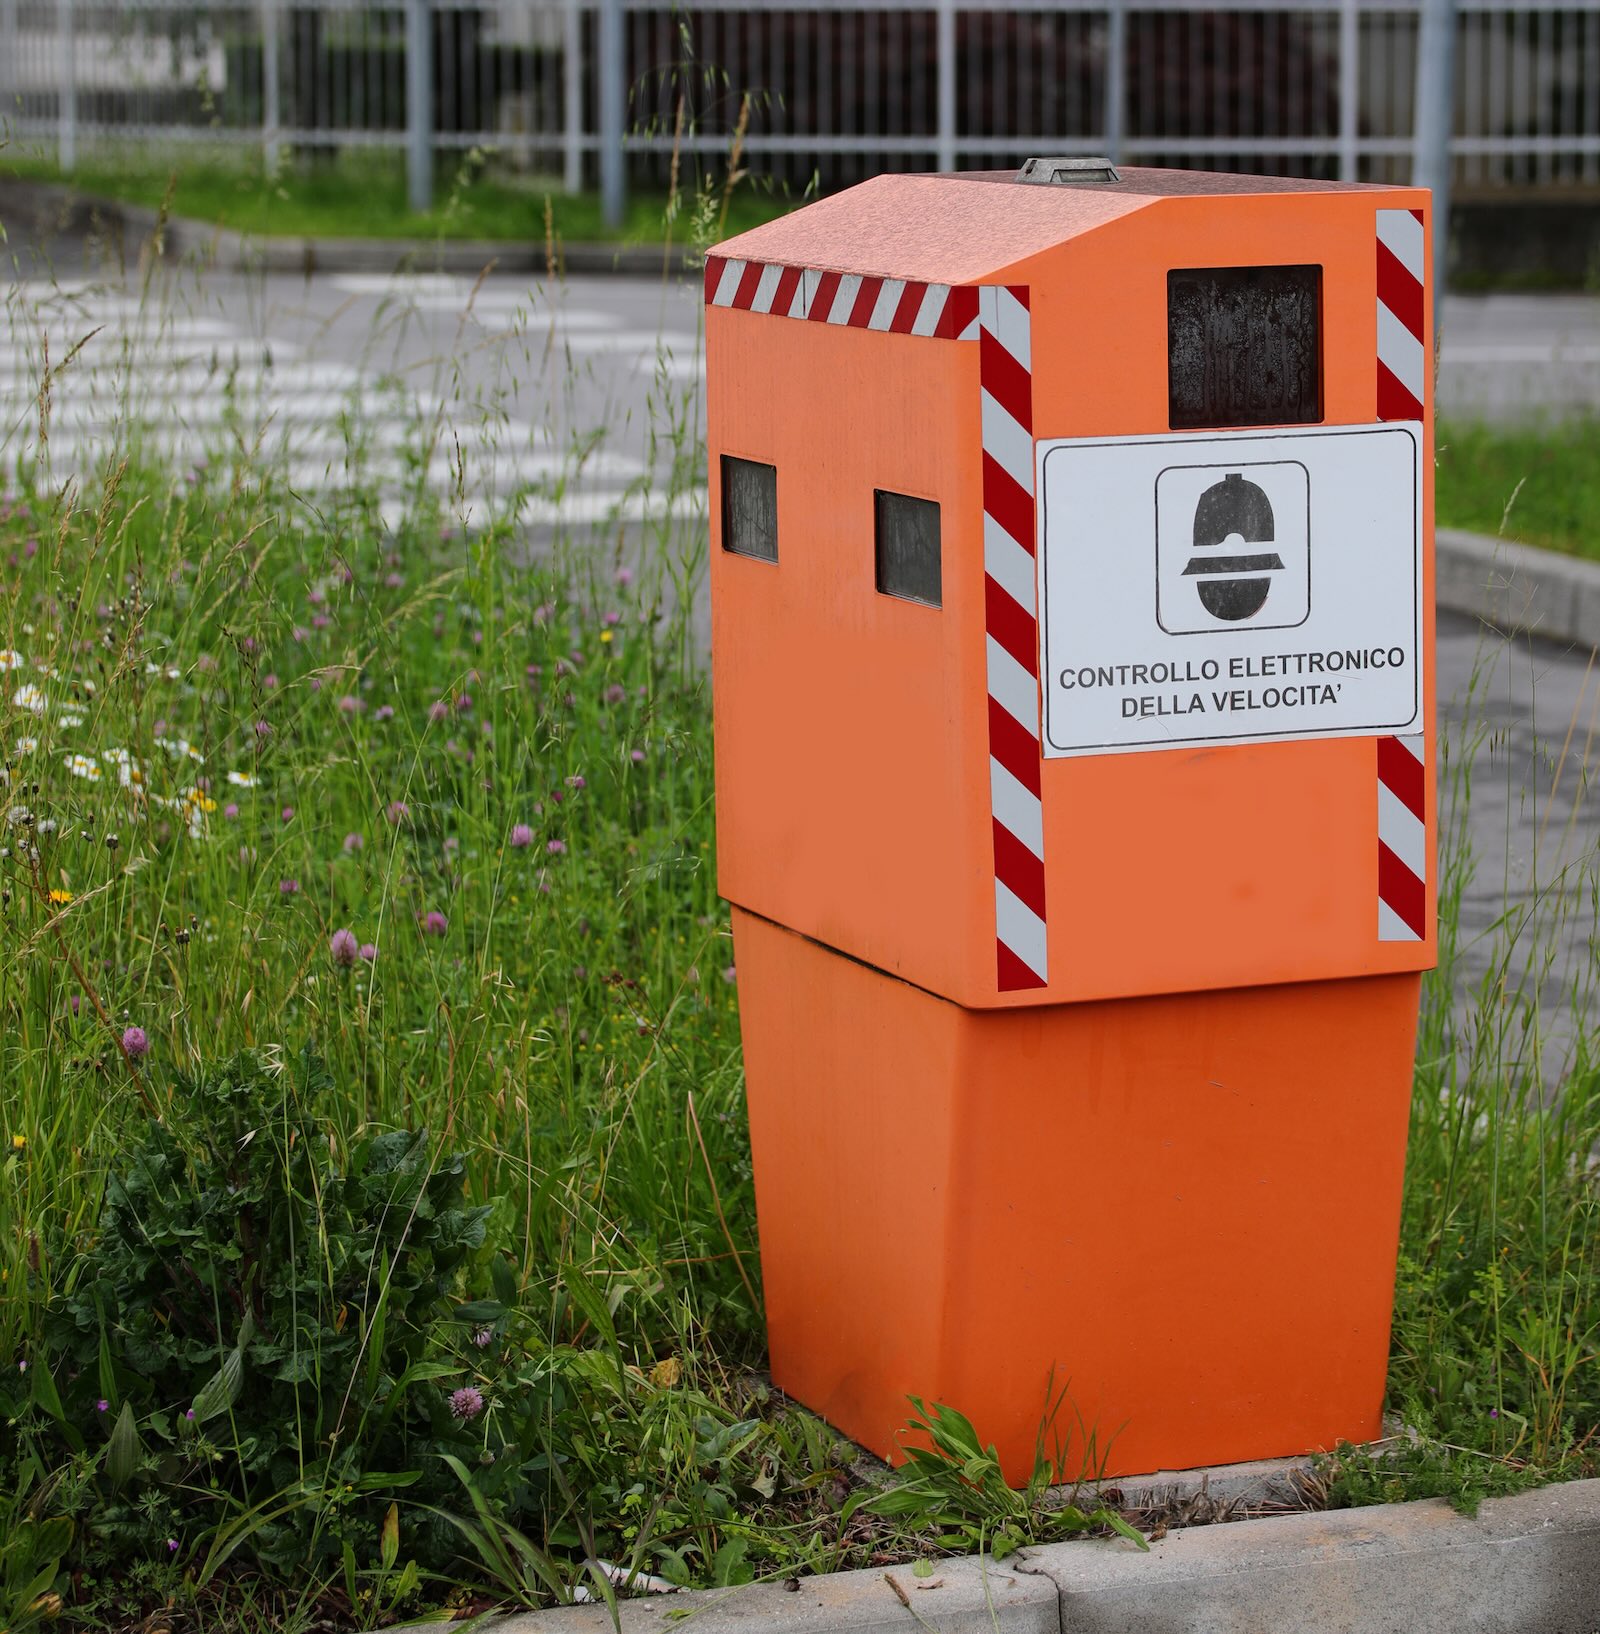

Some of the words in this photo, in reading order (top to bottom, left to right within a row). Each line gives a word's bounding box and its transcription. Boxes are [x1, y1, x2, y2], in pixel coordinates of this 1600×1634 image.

[1059, 659, 1220, 690] CONTROLLO
[1229, 646, 1405, 679] ELETTRONICO
[1121, 693, 1206, 718] DELLA
